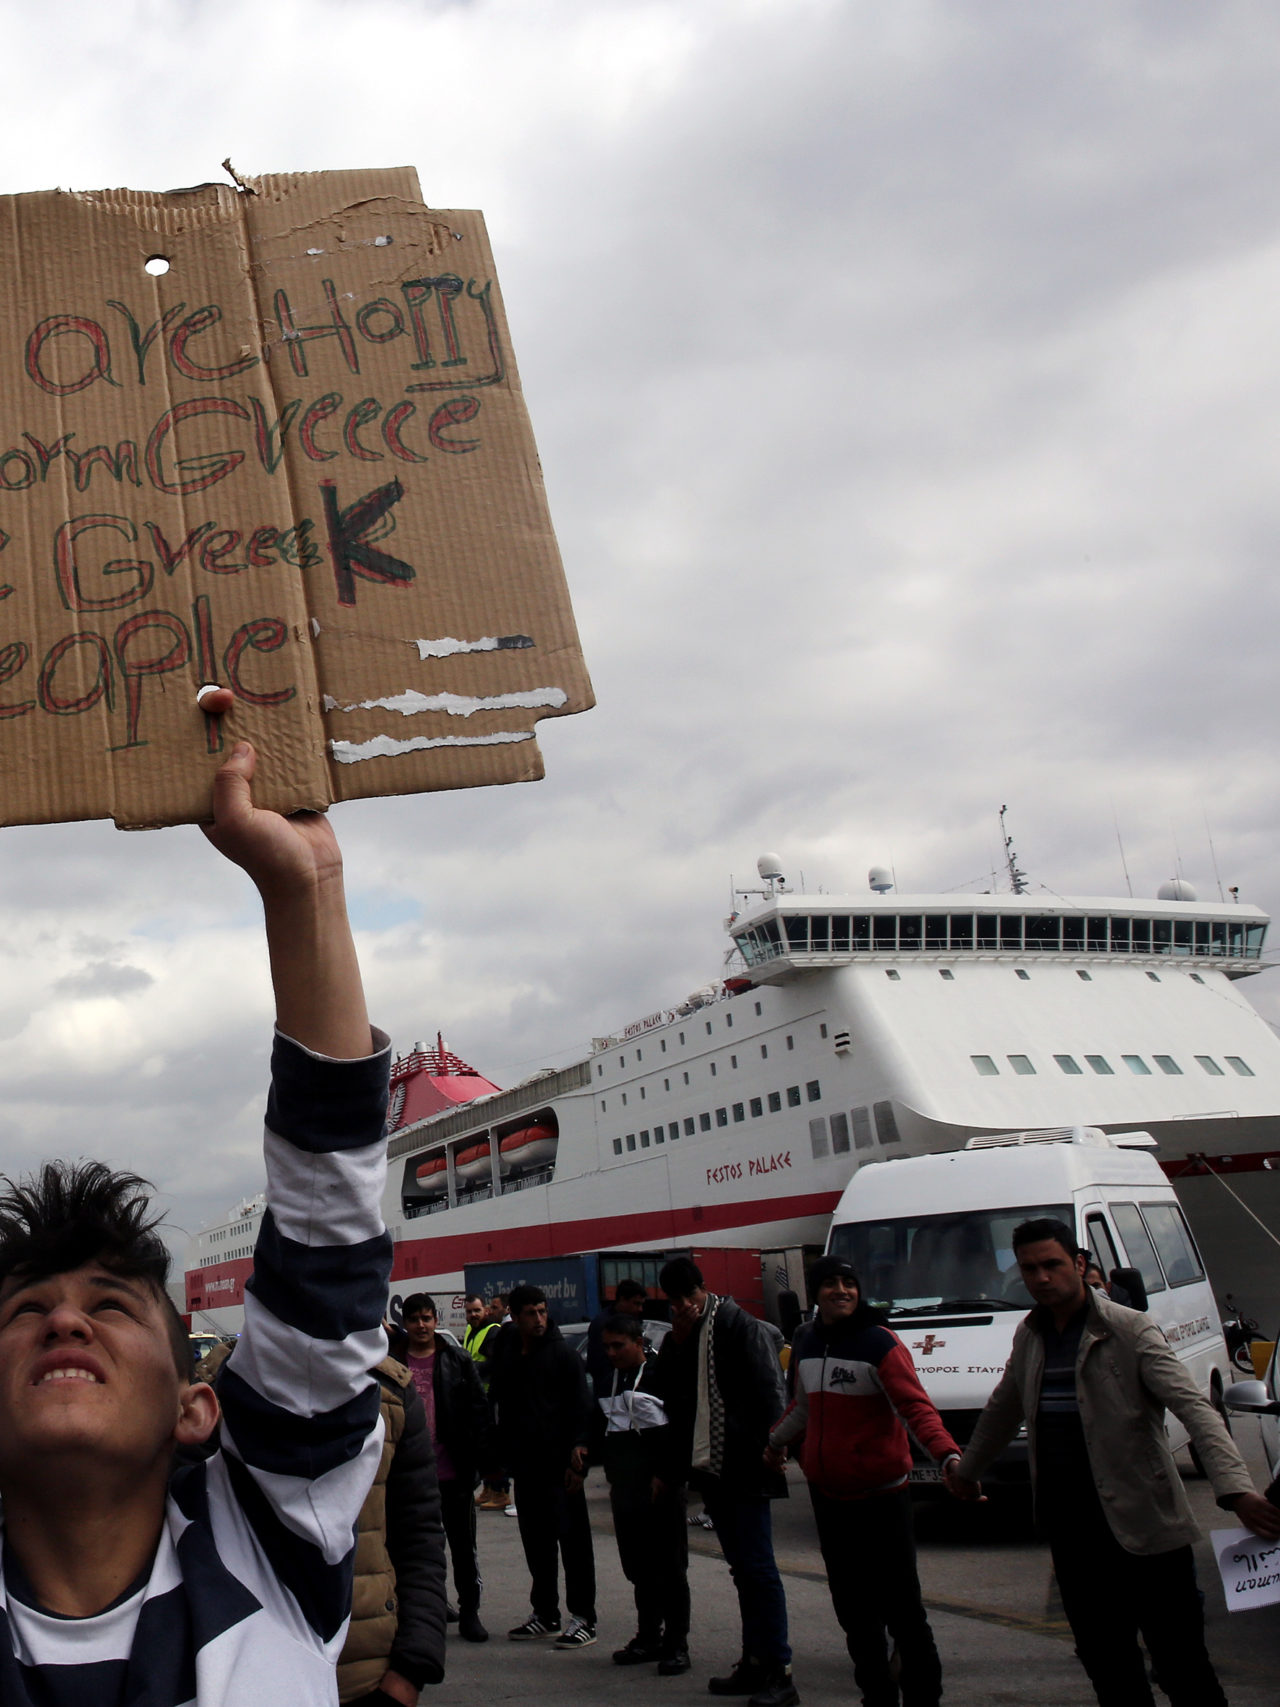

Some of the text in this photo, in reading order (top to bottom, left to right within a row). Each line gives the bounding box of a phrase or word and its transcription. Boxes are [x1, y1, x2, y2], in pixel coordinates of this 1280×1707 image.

[26, 299, 260, 396] are
[706, 1150, 792, 1186] FESTOS PALACE
